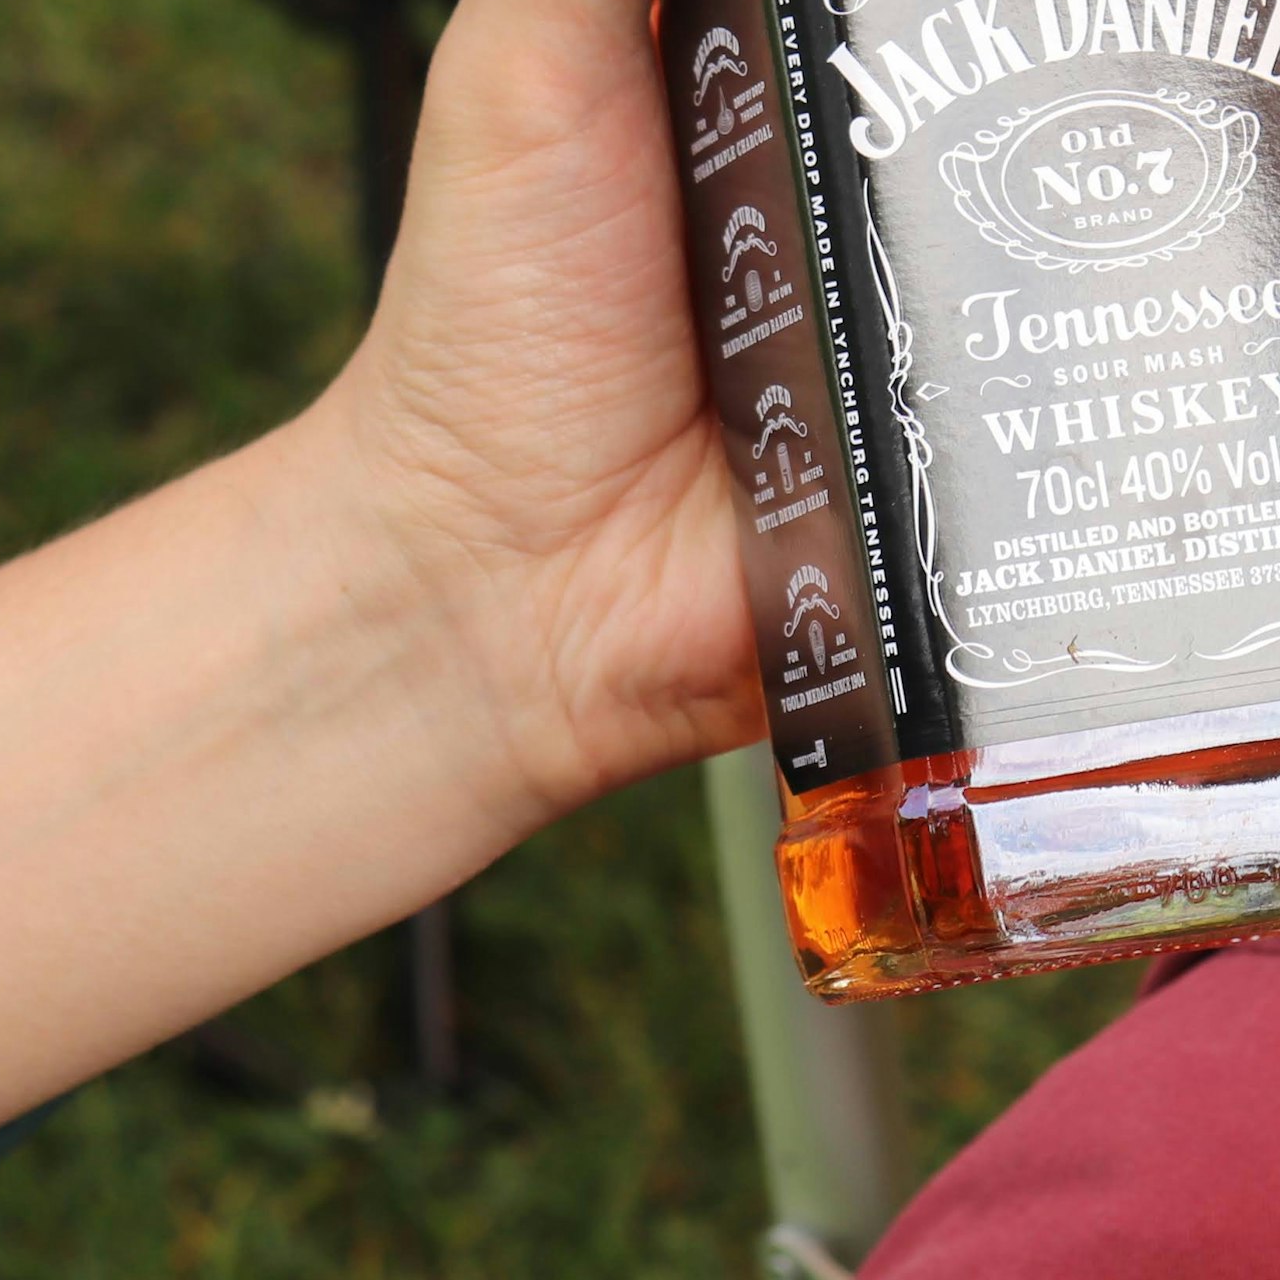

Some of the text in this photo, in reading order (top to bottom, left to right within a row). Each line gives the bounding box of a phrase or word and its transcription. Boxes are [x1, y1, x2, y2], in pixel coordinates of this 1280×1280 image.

[736, 124, 774, 157] CHARCOAL
[1061, 123, 1135, 153] Old
[1032, 148, 1174, 210] No.7
[723, 206, 765, 255] MATURED
[1074, 208, 1153, 229] BRAND
[722, 305, 803, 359] HANDCRAFTED BARRELS
[781, 16, 898, 658] EVERY DROP MADE IN LYNCHBURG TENNESSEE
[1053, 345, 1224, 386] SOUR MASH
[755, 385, 792, 421] TASTED
[806, 489, 829, 512] READY
[1016, 460, 1110, 519] 70cl
[1120, 445, 1212, 502] 40%
[994, 525, 1119, 560] DISTILLED
[1127, 516, 1176, 541] AND
[786, 565, 828, 609] AWARDED
[956, 561, 1044, 596] JACK
[1049, 542, 1176, 582] DANIEL
[966, 588, 1110, 628] LYNCHBURG,
[1112, 568, 1245, 605] TENNESSEE
[786, 693, 806, 712] GOLD
